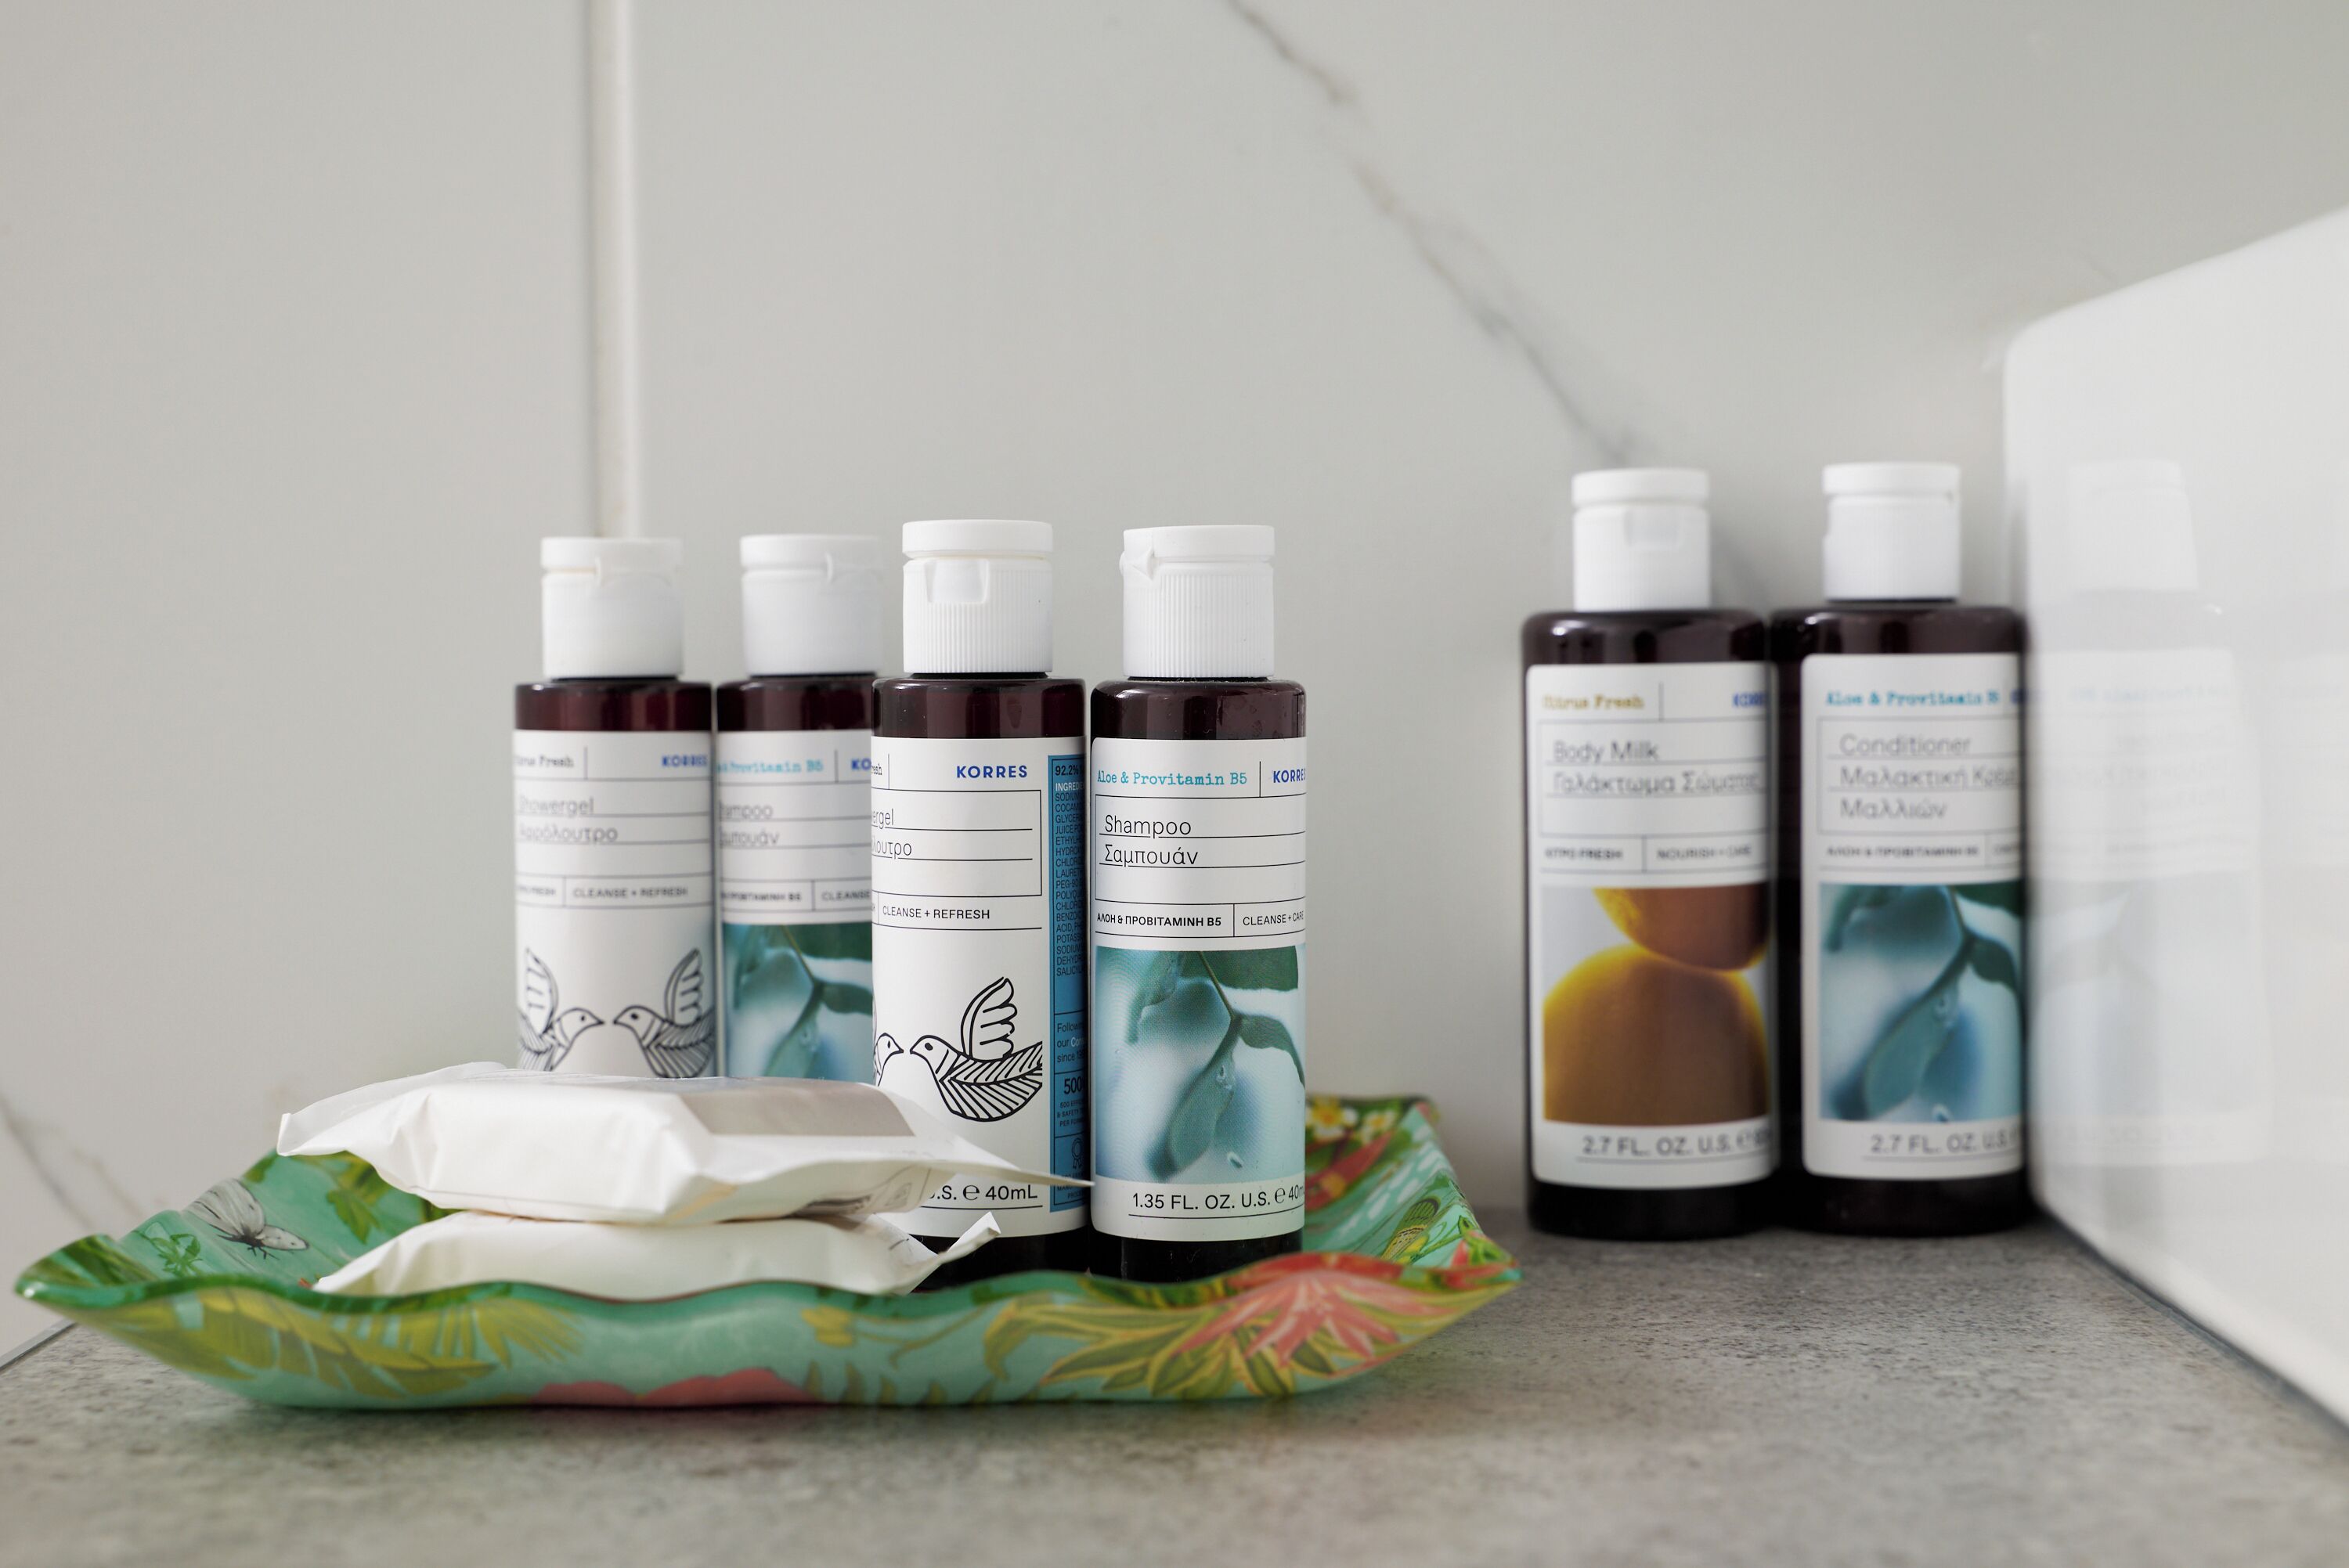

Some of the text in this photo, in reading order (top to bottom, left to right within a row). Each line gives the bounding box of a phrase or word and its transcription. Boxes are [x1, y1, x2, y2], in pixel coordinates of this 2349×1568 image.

[1553, 740, 1660, 764] Body Milk
[1839, 733, 1971, 756] Conditioner
[956, 765, 1028, 779] KORRES
[1097, 770, 1117, 784] Aloe
[1120, 771, 1129, 784] &
[1133, 772, 1225, 786] Provitamin
[1230, 772, 1247, 785] B5
[1105, 814, 1192, 839] Shampoo
[1105, 844, 1198, 867] Σαμπουάν
[882, 906, 922, 918] CLEANSE
[933, 909, 990, 919] REFRESH
[1243, 914, 1286, 926] CLEANSE
[1617, 1135, 1651, 1156] FL.
[1656, 1135, 1694, 1156] OZ.
[929, 1185, 957, 1200] .S.
[985, 1184, 1037, 1200] 40mL
[1133, 1192, 1164, 1209] 1.35
[1171, 1195, 1199, 1209] FL.
[1205, 1195, 1235, 1209] OZ.
[1241, 1191, 1270, 1208] U.S.
